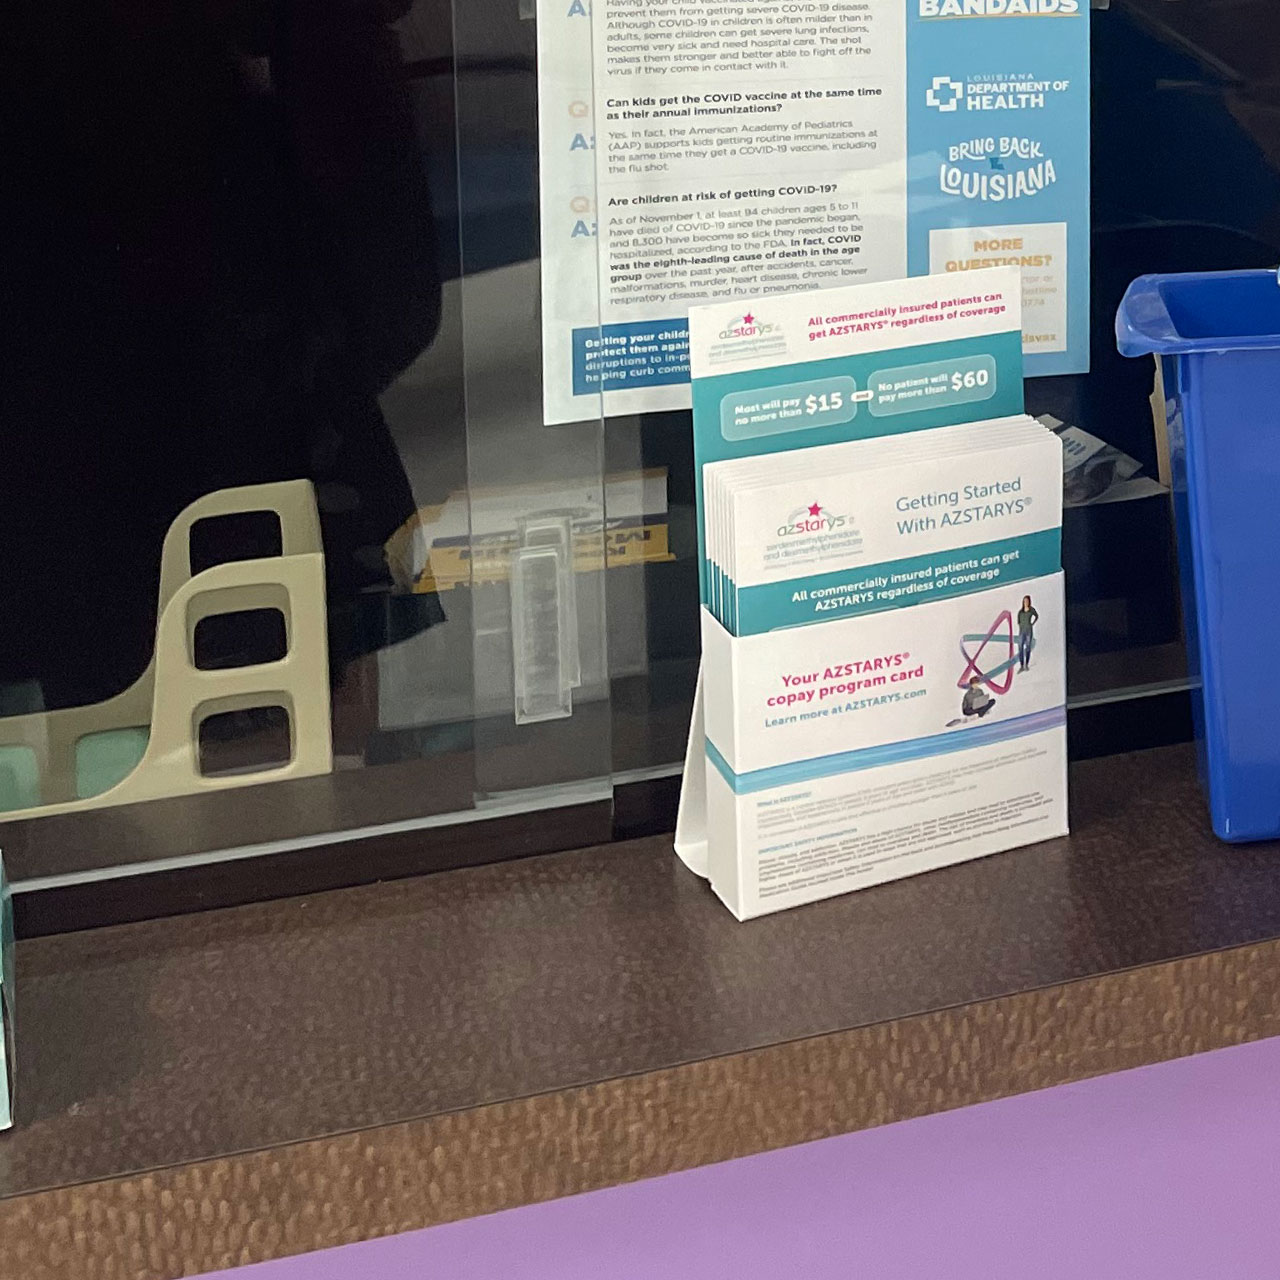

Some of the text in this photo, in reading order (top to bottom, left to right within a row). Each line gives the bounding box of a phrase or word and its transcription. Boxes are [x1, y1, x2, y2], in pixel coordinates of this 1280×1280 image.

[966, 73, 1033, 82] LOUISIANA
[967, 80, 1069, 94] DEPARTMENT OF
[606, 87, 881, 107] Can kids get the COVID vaccine at the same time
[966, 93, 1043, 110] HEALTH
[622, 109, 649, 119] their
[652, 107, 690, 117] annual
[693, 103, 782, 115] immunizations?
[949, 137, 1044, 161] BRING BACK
[940, 159, 1057, 202] LOUISIANA
[607, 183, 837, 206] Are children at risk of getting COVID-19?
[973, 237, 1023, 252] MORE
[807, 293, 1002, 326] All commercially insured patients can
[808, 329, 826, 341] get
[890, 313, 944, 328] regardless
[946, 309, 957, 319] of
[959, 305, 1005, 317] coverage
[878, 373, 948, 391] No patient will
[951, 369, 988, 391] $60
[805, 391, 842, 414] $15
[878, 385, 946, 404] pay more than
[734, 398, 800, 414] Most will pay
[734, 408, 802, 425] no more than
[896, 476, 1021, 511] Getting Started
[896, 516, 935, 534] With
[791, 549, 1019, 602] All commercially insured patients can get
[814, 568, 999, 611] AZSTARYS regardless of coverage
[766, 664, 923, 706] copay program card
[781, 672, 819, 687] Your
[764, 688, 926, 727] Learn more at AZSTARYS.com
